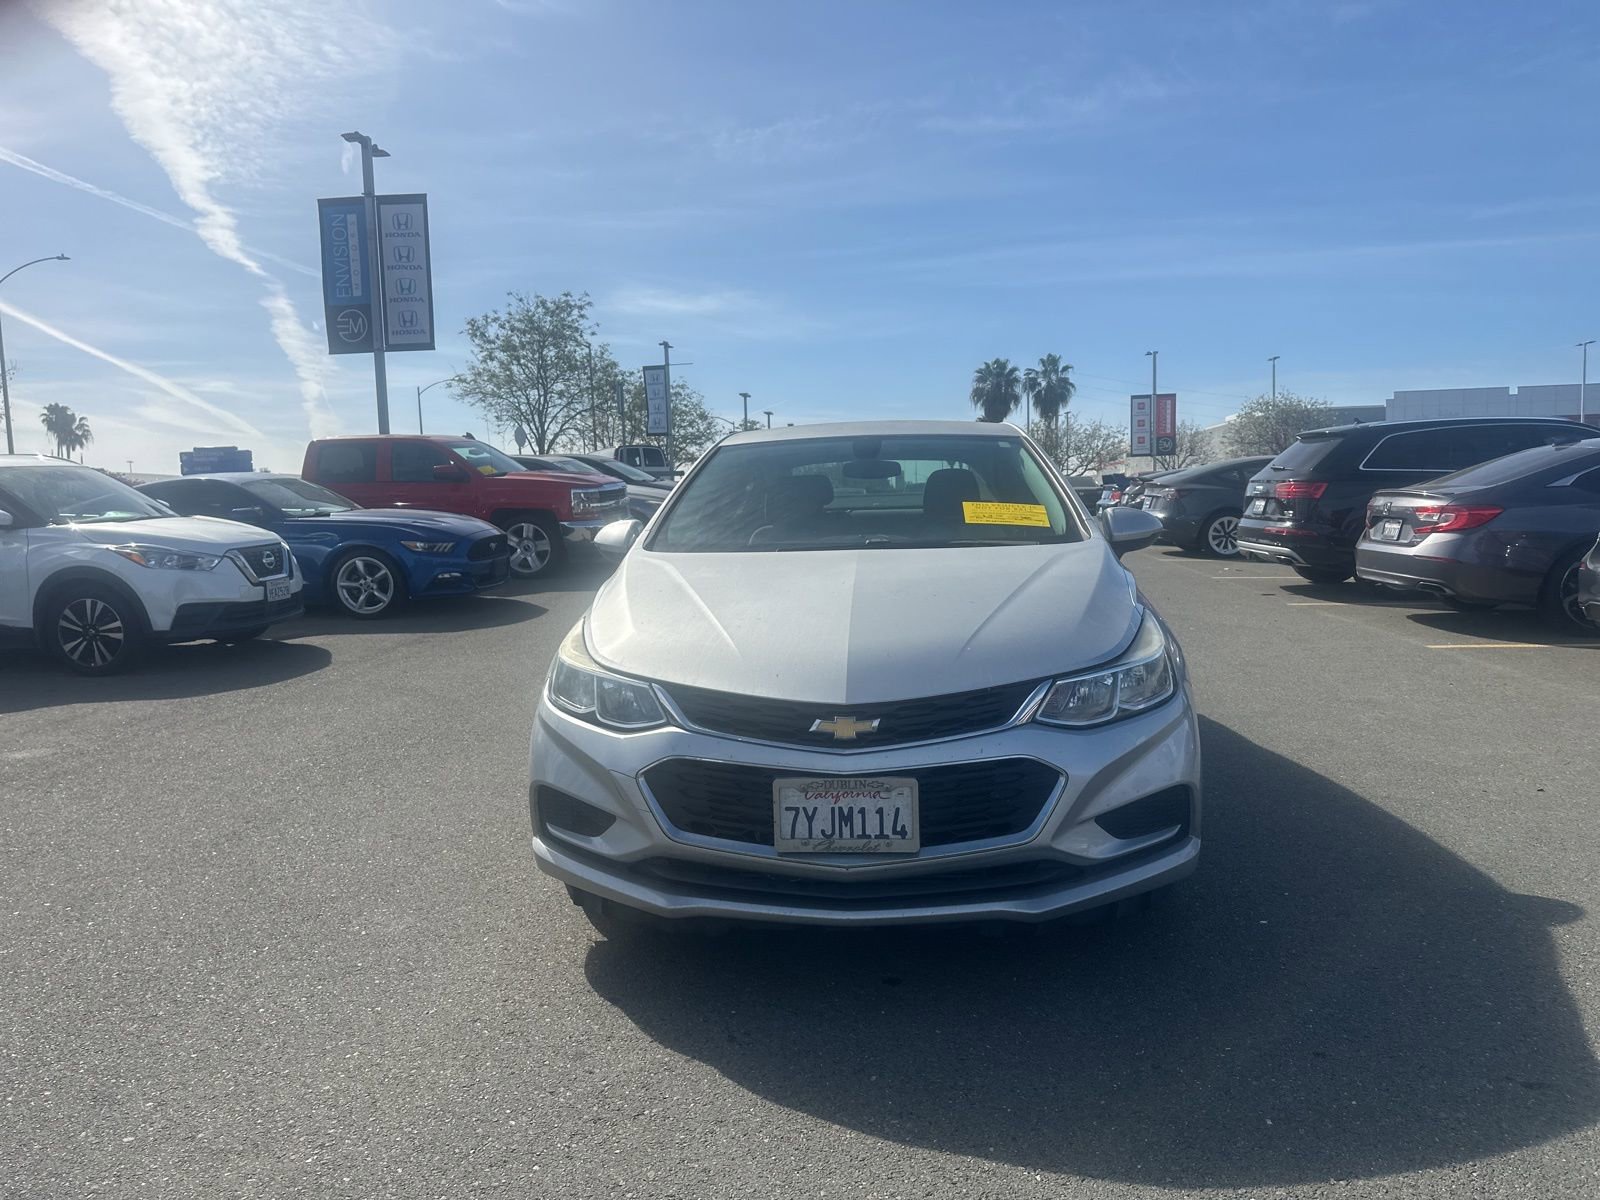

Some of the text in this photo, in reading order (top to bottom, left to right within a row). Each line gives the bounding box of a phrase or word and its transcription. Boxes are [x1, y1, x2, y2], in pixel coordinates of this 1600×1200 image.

[332, 213, 351, 298] ENVISION
[823, 779, 867, 790] DUBLIN
[785, 806, 908, 839] 7YJM114
